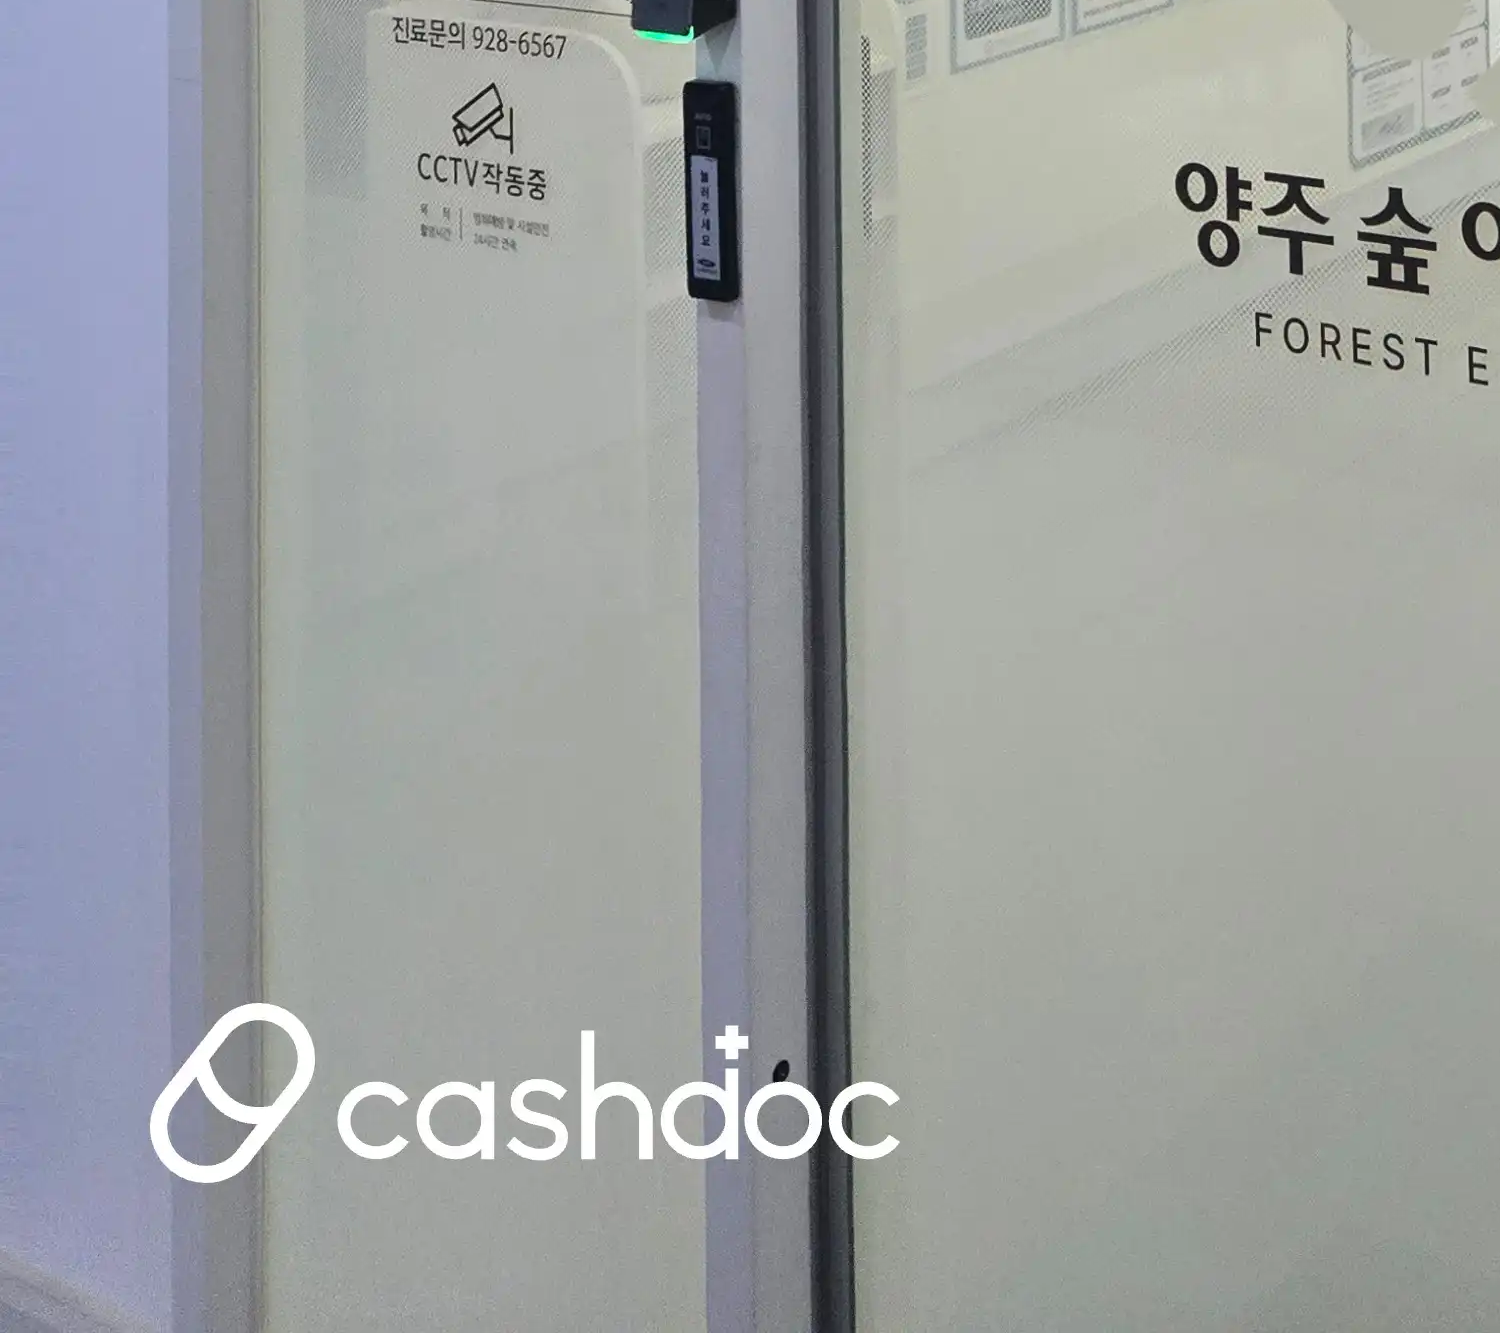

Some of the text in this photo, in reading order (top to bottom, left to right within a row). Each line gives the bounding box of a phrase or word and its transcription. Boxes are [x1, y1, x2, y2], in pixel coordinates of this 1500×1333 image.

[392, 16, 567, 60] 진료문의 928-6567
[1175, 162, 1334, 275] 양주
[1357, 186, 1438, 295] 숲
[1254, 312, 1438, 372] FOREST
